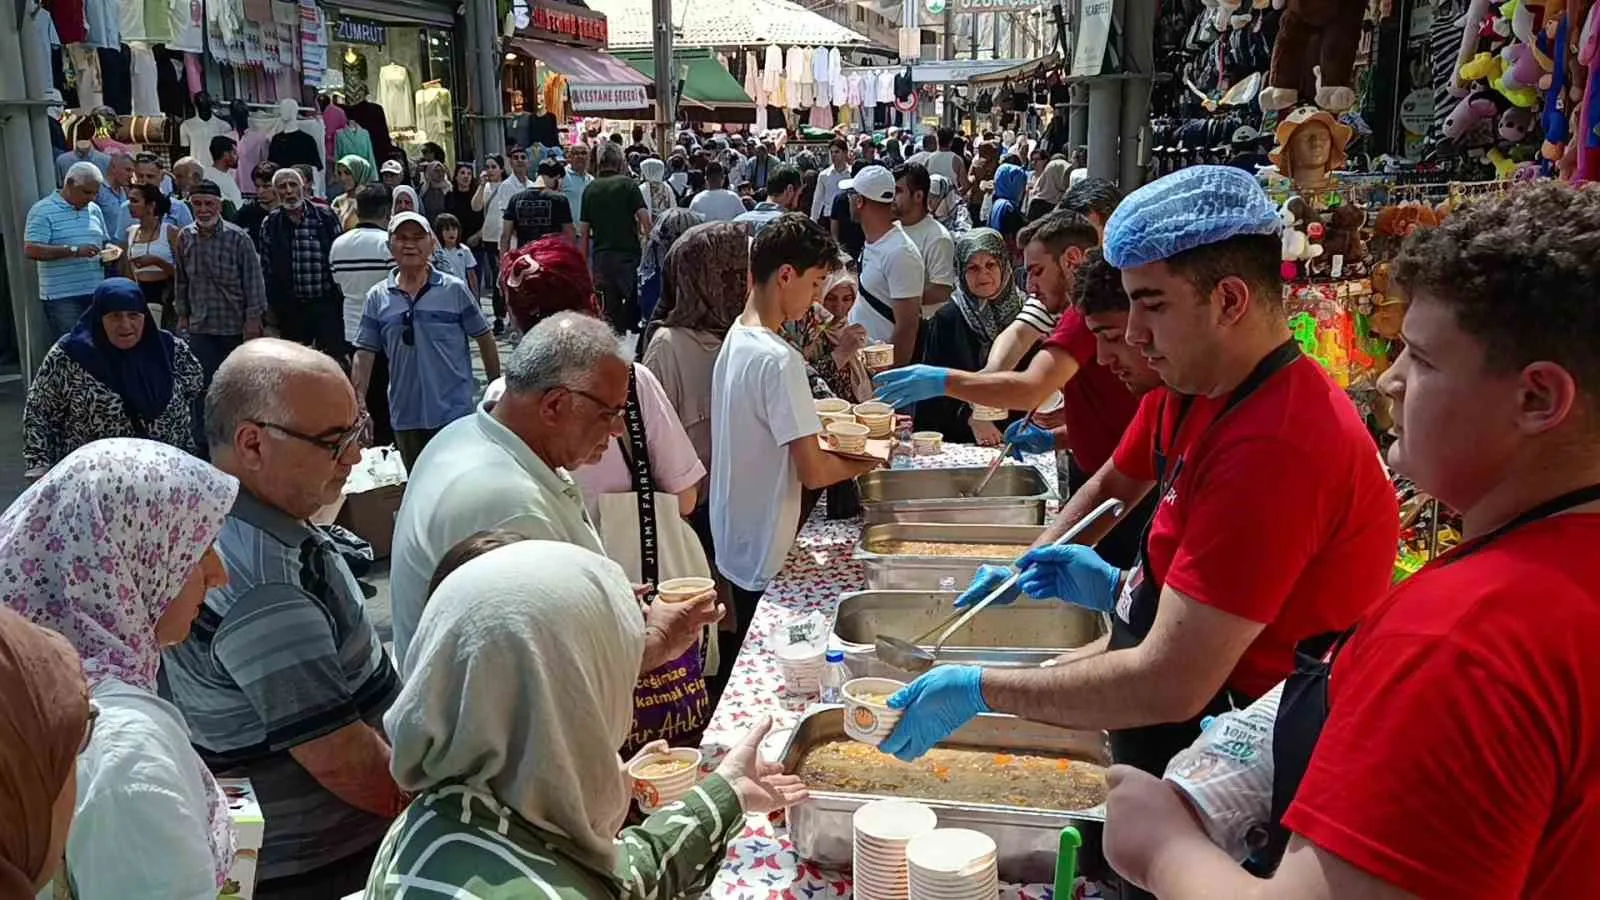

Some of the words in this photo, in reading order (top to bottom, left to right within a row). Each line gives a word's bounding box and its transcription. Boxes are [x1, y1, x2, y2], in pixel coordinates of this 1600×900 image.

[336, 17, 384, 43] ZÜMRÜT
[626, 400, 644, 449] JIMMY
[639, 460, 652, 510] FAIRLY
[644, 515, 655, 565] JIMMY
